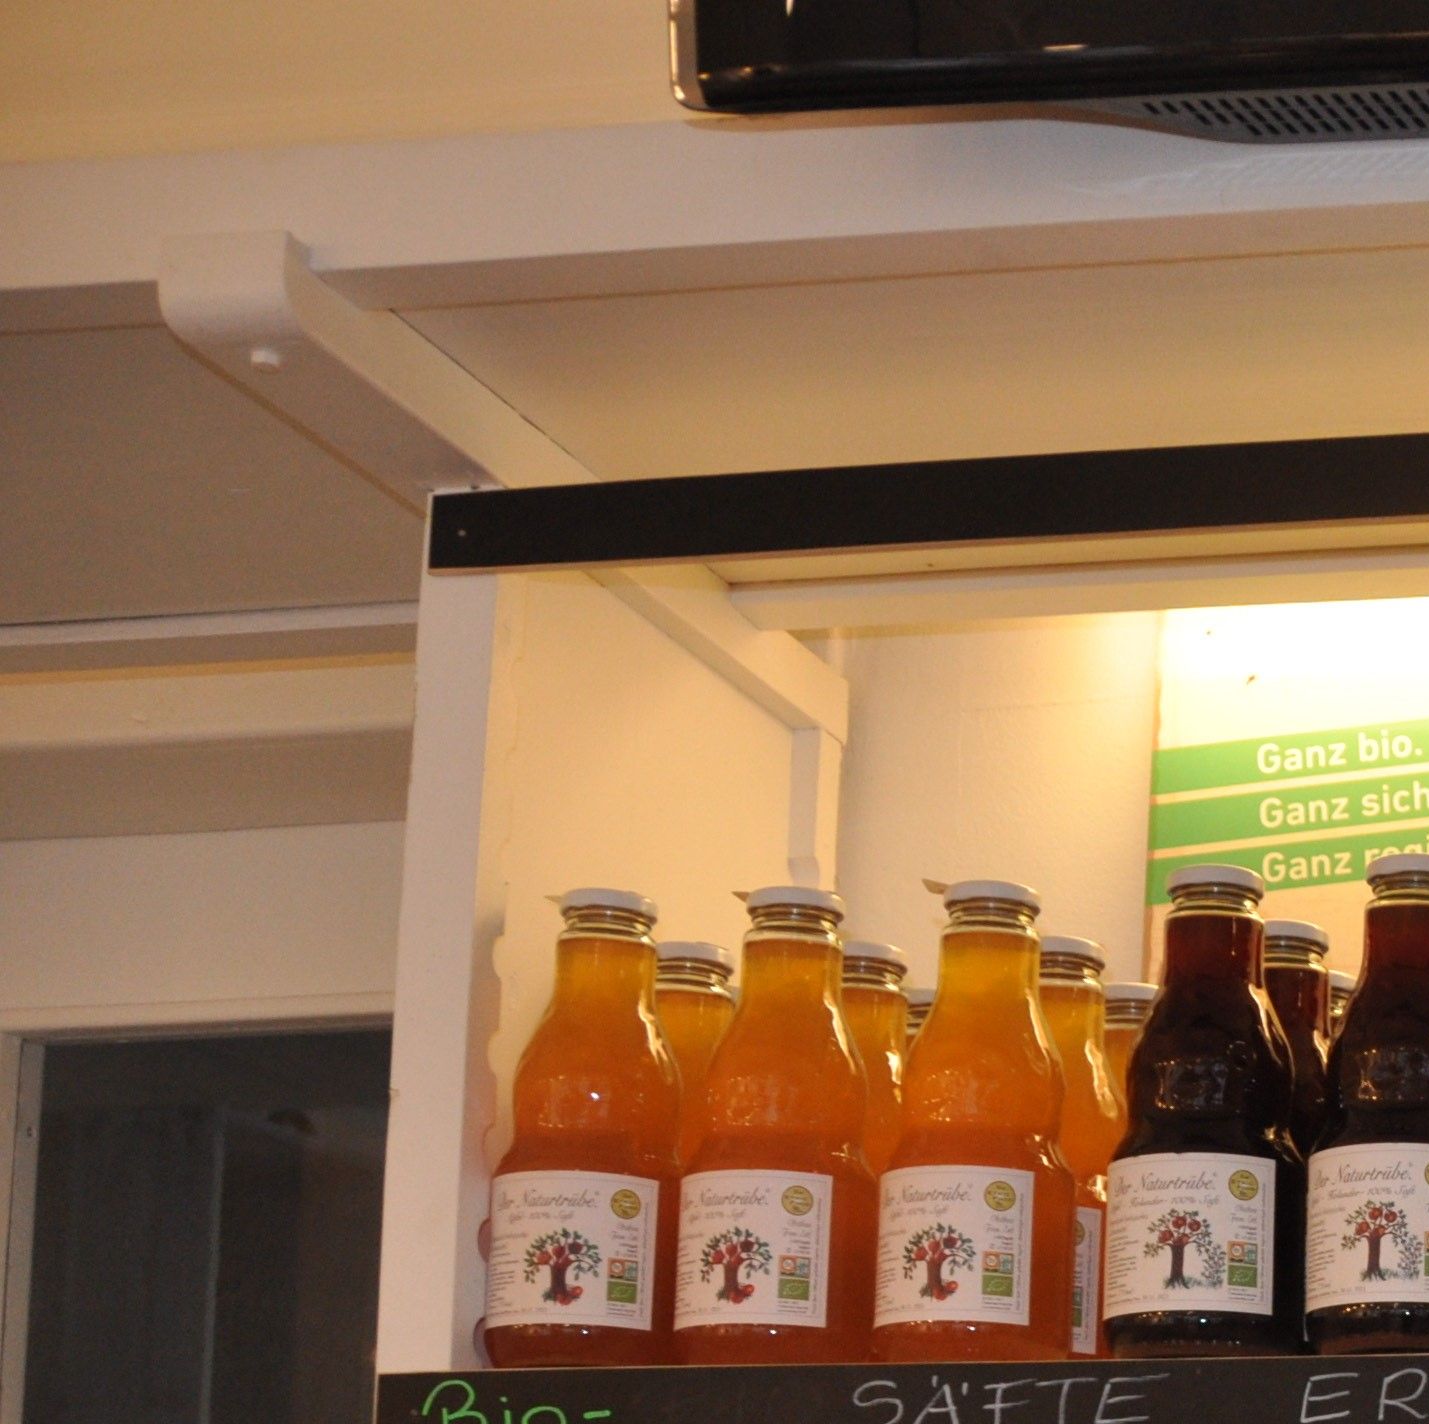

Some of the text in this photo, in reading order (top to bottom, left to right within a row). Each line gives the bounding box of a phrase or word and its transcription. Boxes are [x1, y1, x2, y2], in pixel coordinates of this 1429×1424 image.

[1256, 731, 1424, 776] Ganz bio.
[1259, 797, 1348, 830] Ganz
[1261, 849, 1352, 884] Ganz
